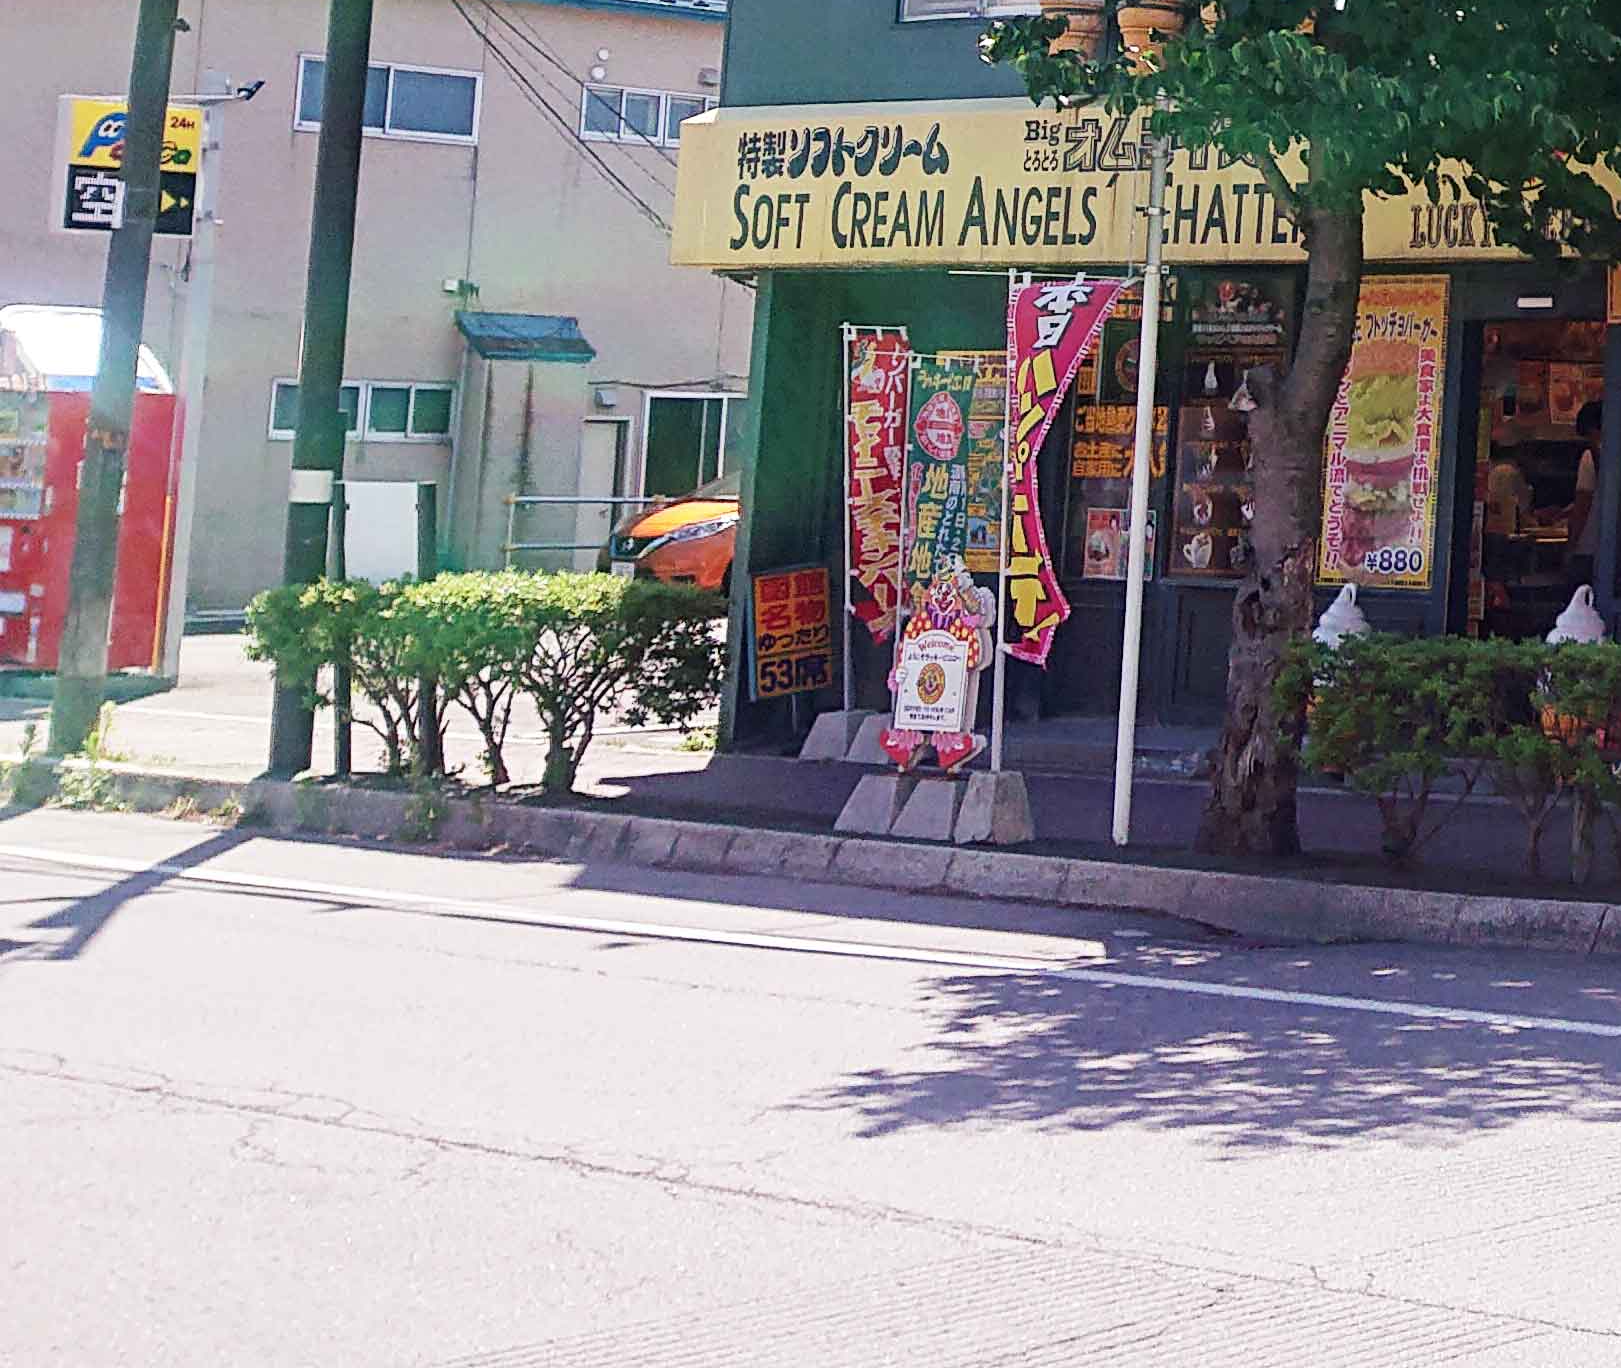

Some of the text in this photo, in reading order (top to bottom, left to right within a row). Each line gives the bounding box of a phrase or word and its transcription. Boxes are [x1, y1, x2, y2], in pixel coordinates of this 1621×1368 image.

[737, 122, 950, 180] 特製ソフトクリーム
[1024, 119, 1062, 146] Big
[728, 183, 811, 250] SOFT
[831, 180, 945, 249] CREAM
[1365, 549, 1423, 575] ¥880
